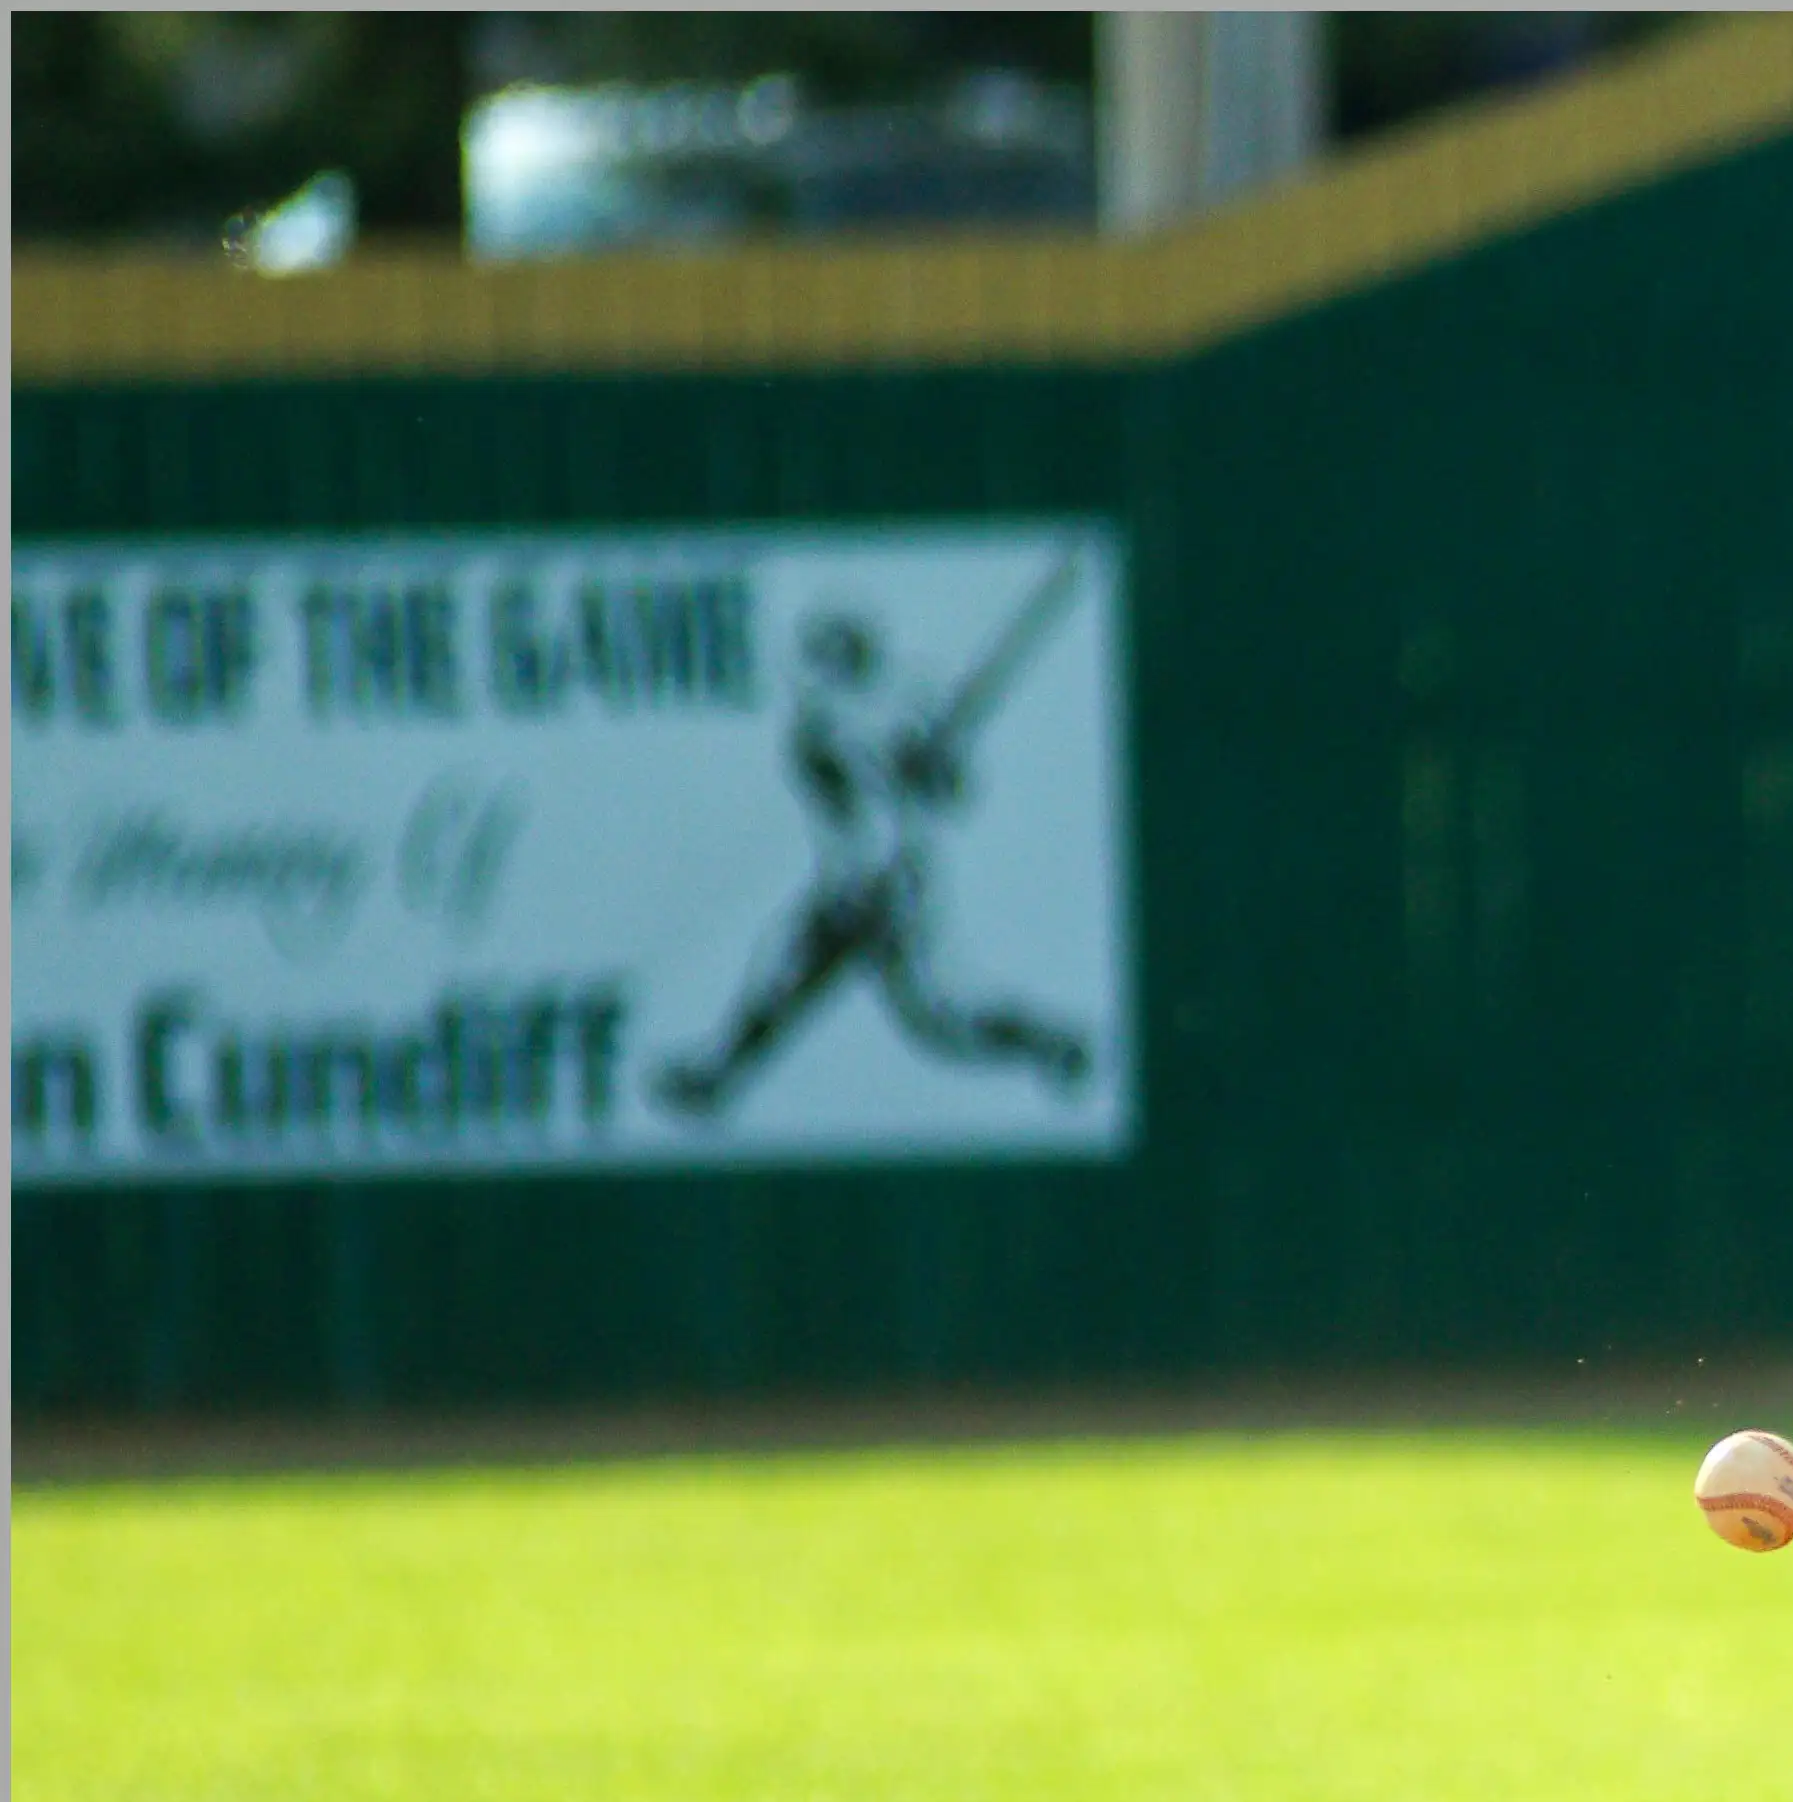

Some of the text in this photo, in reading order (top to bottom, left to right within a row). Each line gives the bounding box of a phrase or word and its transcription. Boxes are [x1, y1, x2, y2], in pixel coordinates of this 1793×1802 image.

[143, 585, 257, 724] OF
[300, 580, 458, 722] THE
[486, 573, 760, 716] GAME
[133, 980, 632, 1138] Cundiff
